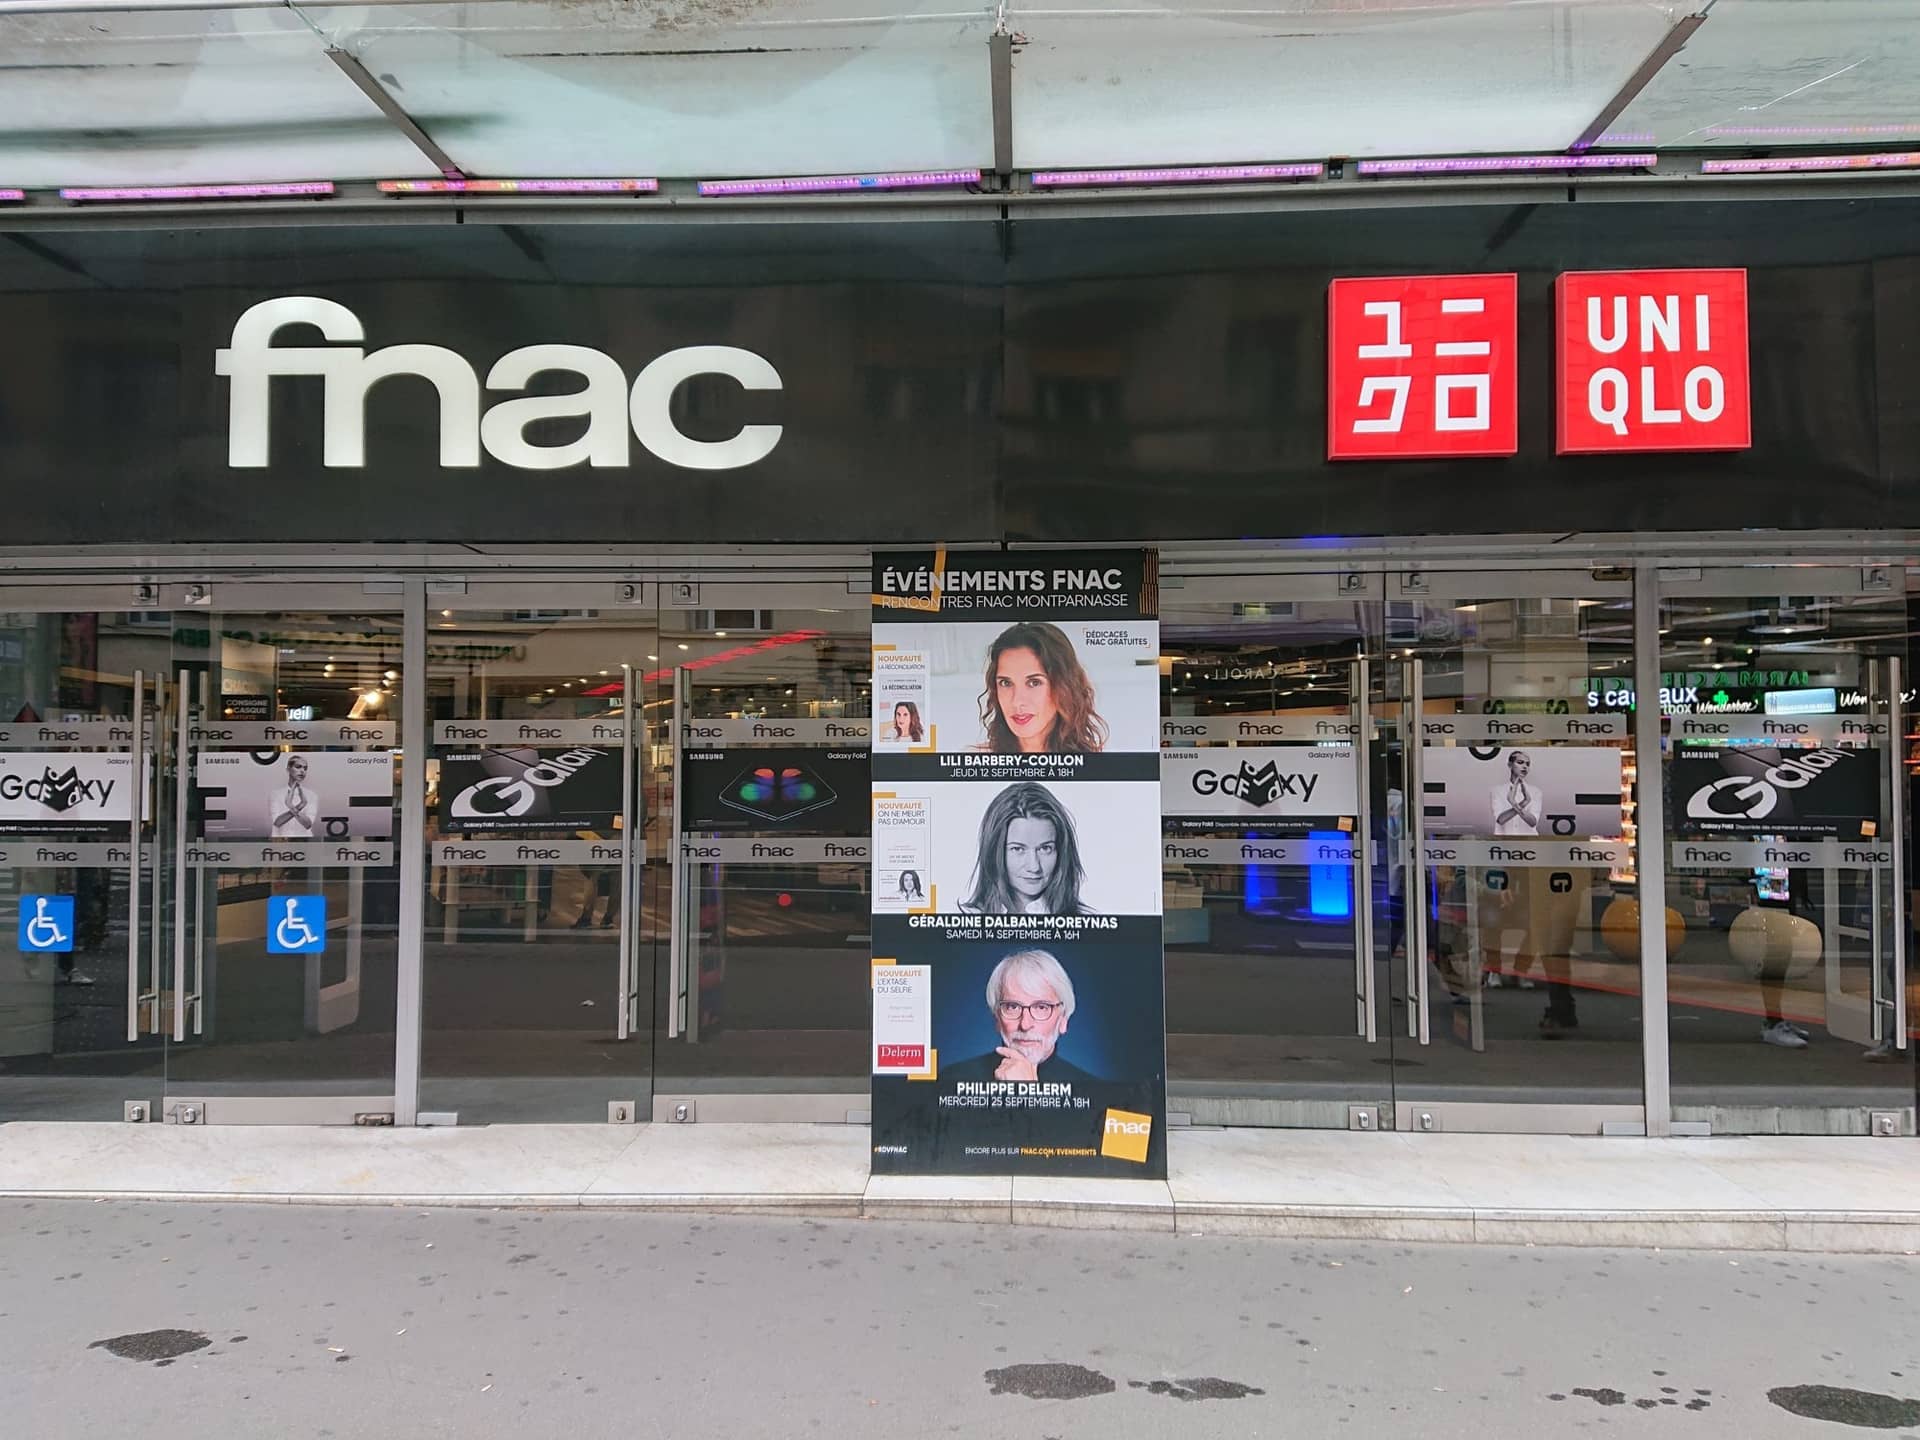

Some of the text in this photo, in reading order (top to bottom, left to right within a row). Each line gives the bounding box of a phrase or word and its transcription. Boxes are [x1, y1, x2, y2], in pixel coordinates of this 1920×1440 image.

[1357, 298, 1490, 359] ユニ
[1587, 294, 1710, 354] UNI
[215, 296, 783, 470] fnac
[1352, 373, 1490, 433] クロ
[1587, 365, 1725, 435] QLO
[882, 566, 1122, 592] ÉVÉNEMENTS FNAC
[882, 593, 1128, 609] RENCONTRES FNAC MONTPARNASSE
[1085, 629, 1128, 639] DÉDICACES
[1107, 637, 1148, 646] GRATUITES
[190, 726, 383, 740] fnac fnac fnac
[445, 725, 488, 739] fnac
[519, 725, 562, 739] fnac
[753, 724, 795, 737] fnac
[825, 724, 868, 737] fnac
[1162, 721, 1361, 735] fnac fnac fnac
[1487, 720, 1534, 734] fnac
[1566, 720, 1614, 734] fnac
[1682, 720, 1887, 734] fnac fnac fnac
[39, 728, 80, 741] fnac
[347, 757, 372, 765] Galaxy
[827, 752, 851, 761] Galaxy
[940, 754, 1084, 767] LILI BARBERY-COULON
[1163, 752, 1199, 760] SAMSUNG
[1307, 751, 1334, 760] Galaxy
[1681, 751, 1719, 760] SAMSUNG
[950, 766, 1074, 778] JEUDI 12 SEPTEMBRE À 18H
[450, 745, 609, 817] Galaxy
[1686, 747, 1856, 819] Galaxy
[37, 848, 78, 861] fnac
[186, 847, 380, 862] fnac fnac fnac
[443, 846, 486, 860] fnac
[517, 846, 560, 859] fnac
[751, 843, 794, 857] fnac
[824, 843, 867, 856] fnac
[1165, 844, 1361, 859] fnac fnac fnac
[1488, 846, 1536, 861] fnac
[1568, 848, 1616, 862] fnac
[1685, 848, 1890, 863] fnac fnac fnac
[908, 914, 1118, 929] GÉRALDINE DALBAN-MOREYNAS
[946, 928, 1080, 940] SAMEDI 14 SEPTEMBRE À 16H
[877, 978, 908, 986] L'EXTASE
[881, 1046, 921, 1057] Delerm
[957, 1082, 1071, 1096] PHILIPPE DELERM
[939, 1096, 1090, 1108] MERCREDI 25 SEPTEMBRE À 18H
[1105, 1118, 1150, 1135] fnac
